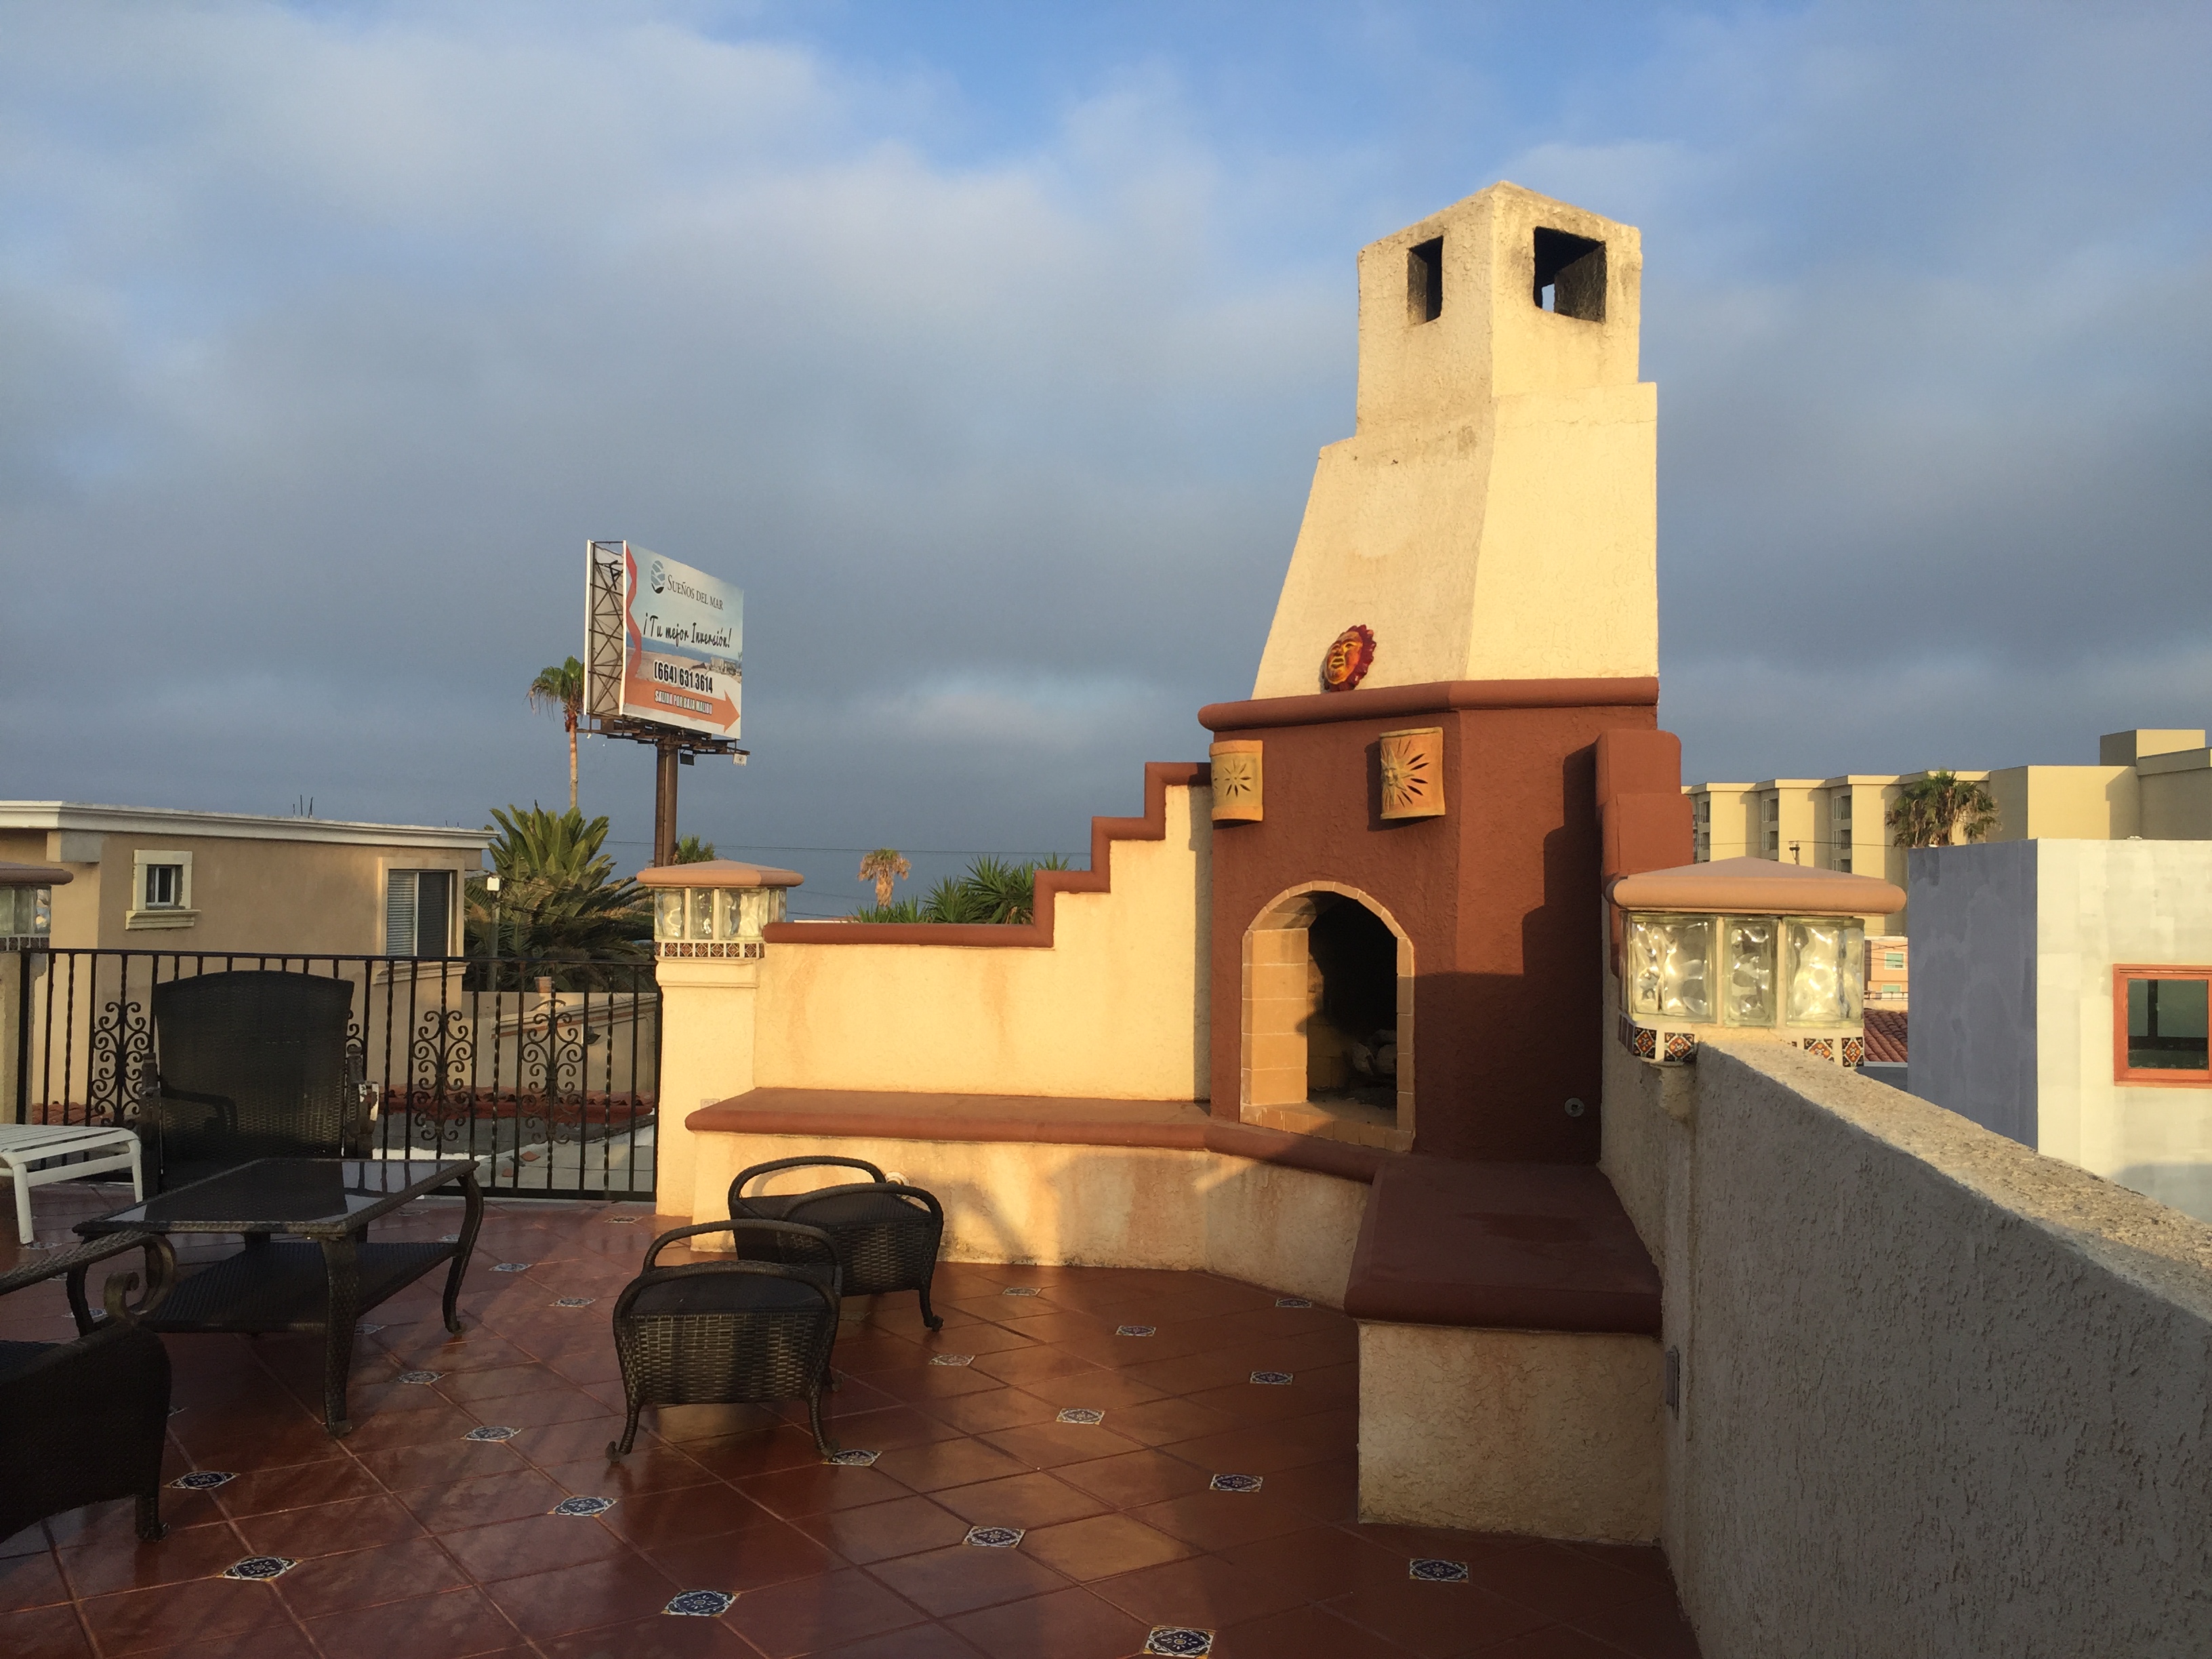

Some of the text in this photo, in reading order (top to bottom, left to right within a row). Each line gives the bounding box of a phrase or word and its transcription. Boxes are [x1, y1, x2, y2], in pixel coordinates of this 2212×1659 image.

[668, 575, 723, 610] SUEÑOS DEL MAR
[643, 613, 732, 648] ¡Tu mejor Inversión!
[654, 661, 677, 683] (664)
[655, 690, 673, 705] SALIDA
[674, 695, 683, 708] POR
[684, 697, 695, 711] BAJA
